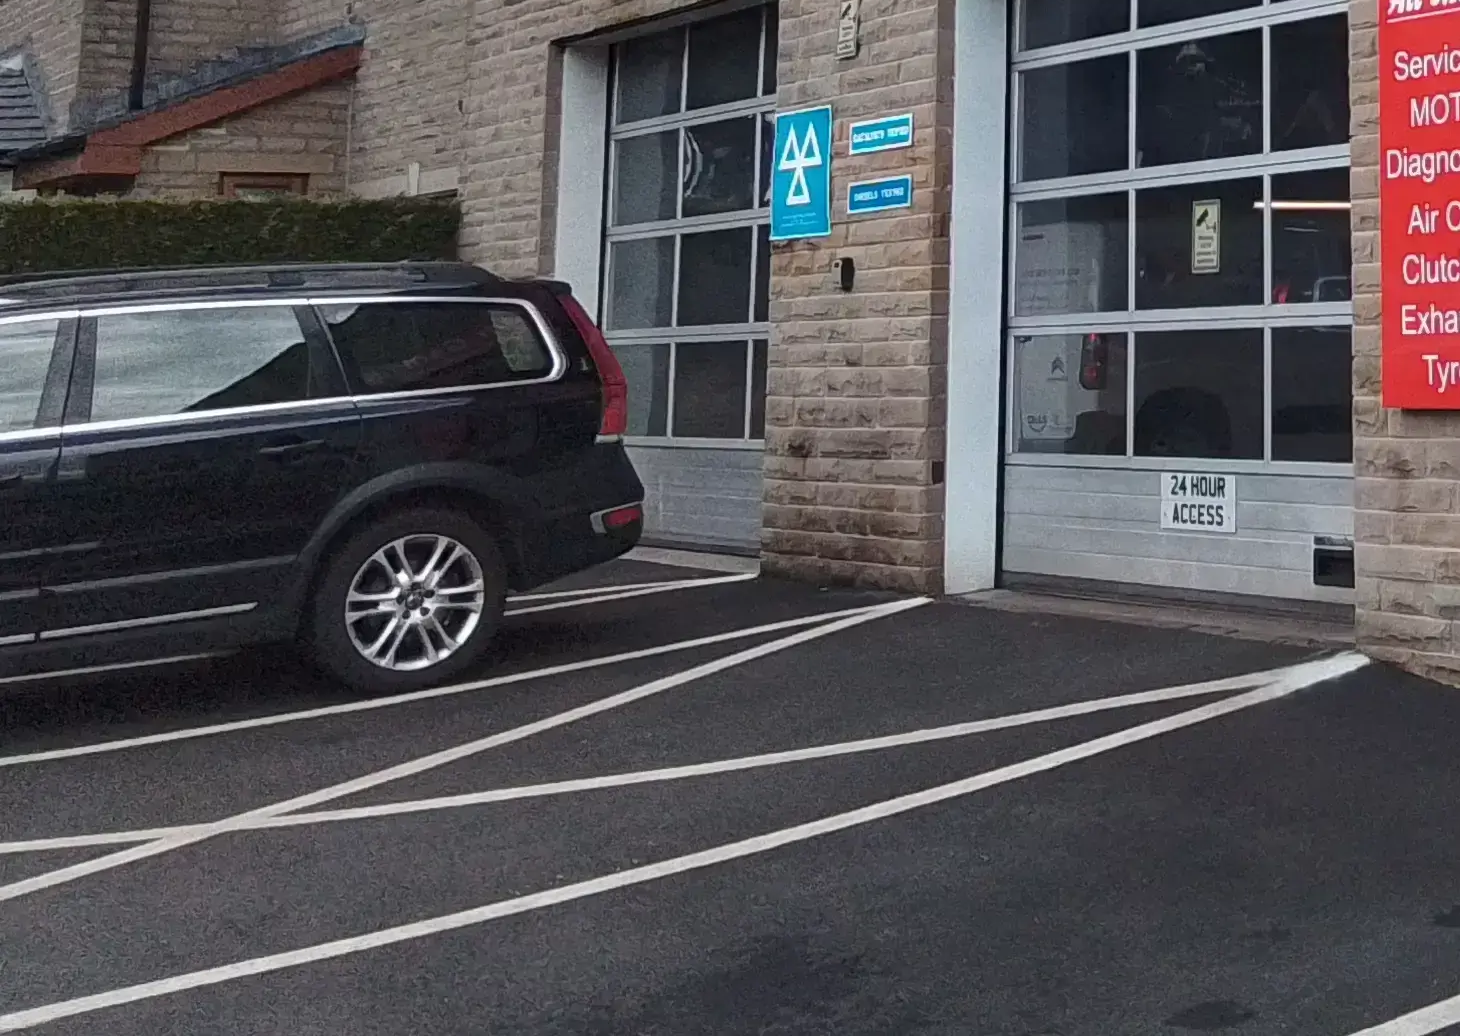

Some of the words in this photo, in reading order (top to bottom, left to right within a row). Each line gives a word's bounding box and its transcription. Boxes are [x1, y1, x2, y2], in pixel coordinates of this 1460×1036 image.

[1407, 202, 1439, 234] Air
[1170, 475, 1187, 496] 24
[1190, 475, 1226, 499] HOUR
[1172, 502, 1224, 526] ACCESS
